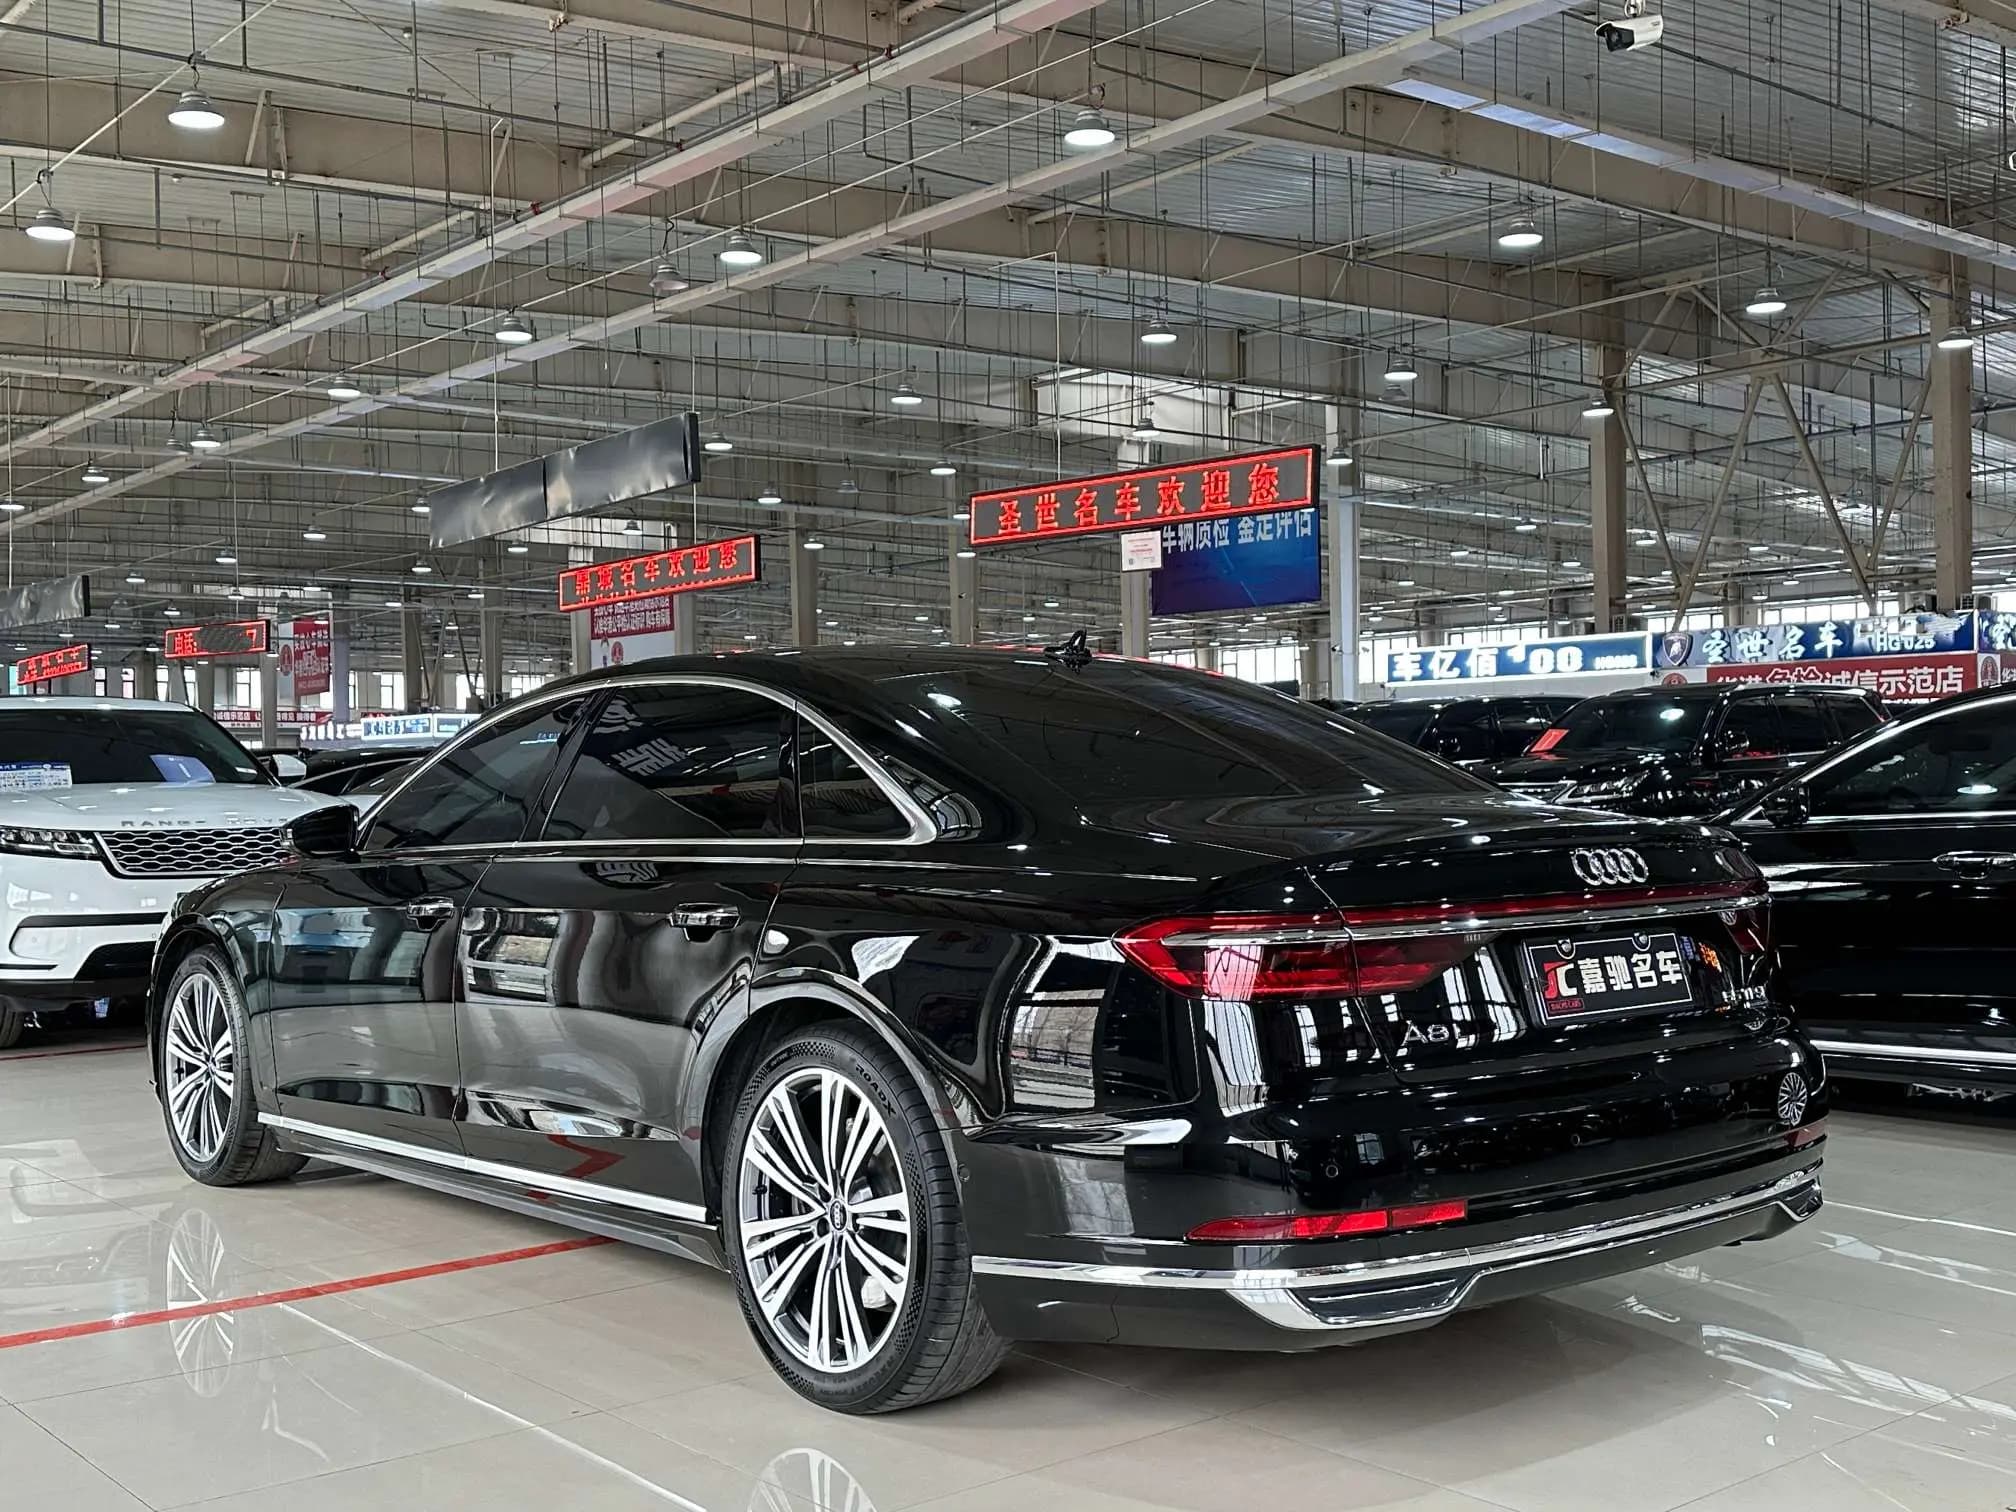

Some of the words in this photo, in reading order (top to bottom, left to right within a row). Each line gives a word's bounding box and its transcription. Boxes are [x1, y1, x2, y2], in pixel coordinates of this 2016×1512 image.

[998, 462, 1280, 536] 圣世名车欢迎您
[1702, 620, 1843, 664] 圣世名车
[1577, 951, 1684, 994] 嘉驰名车
[855, 1064, 896, 1117] ROADX
